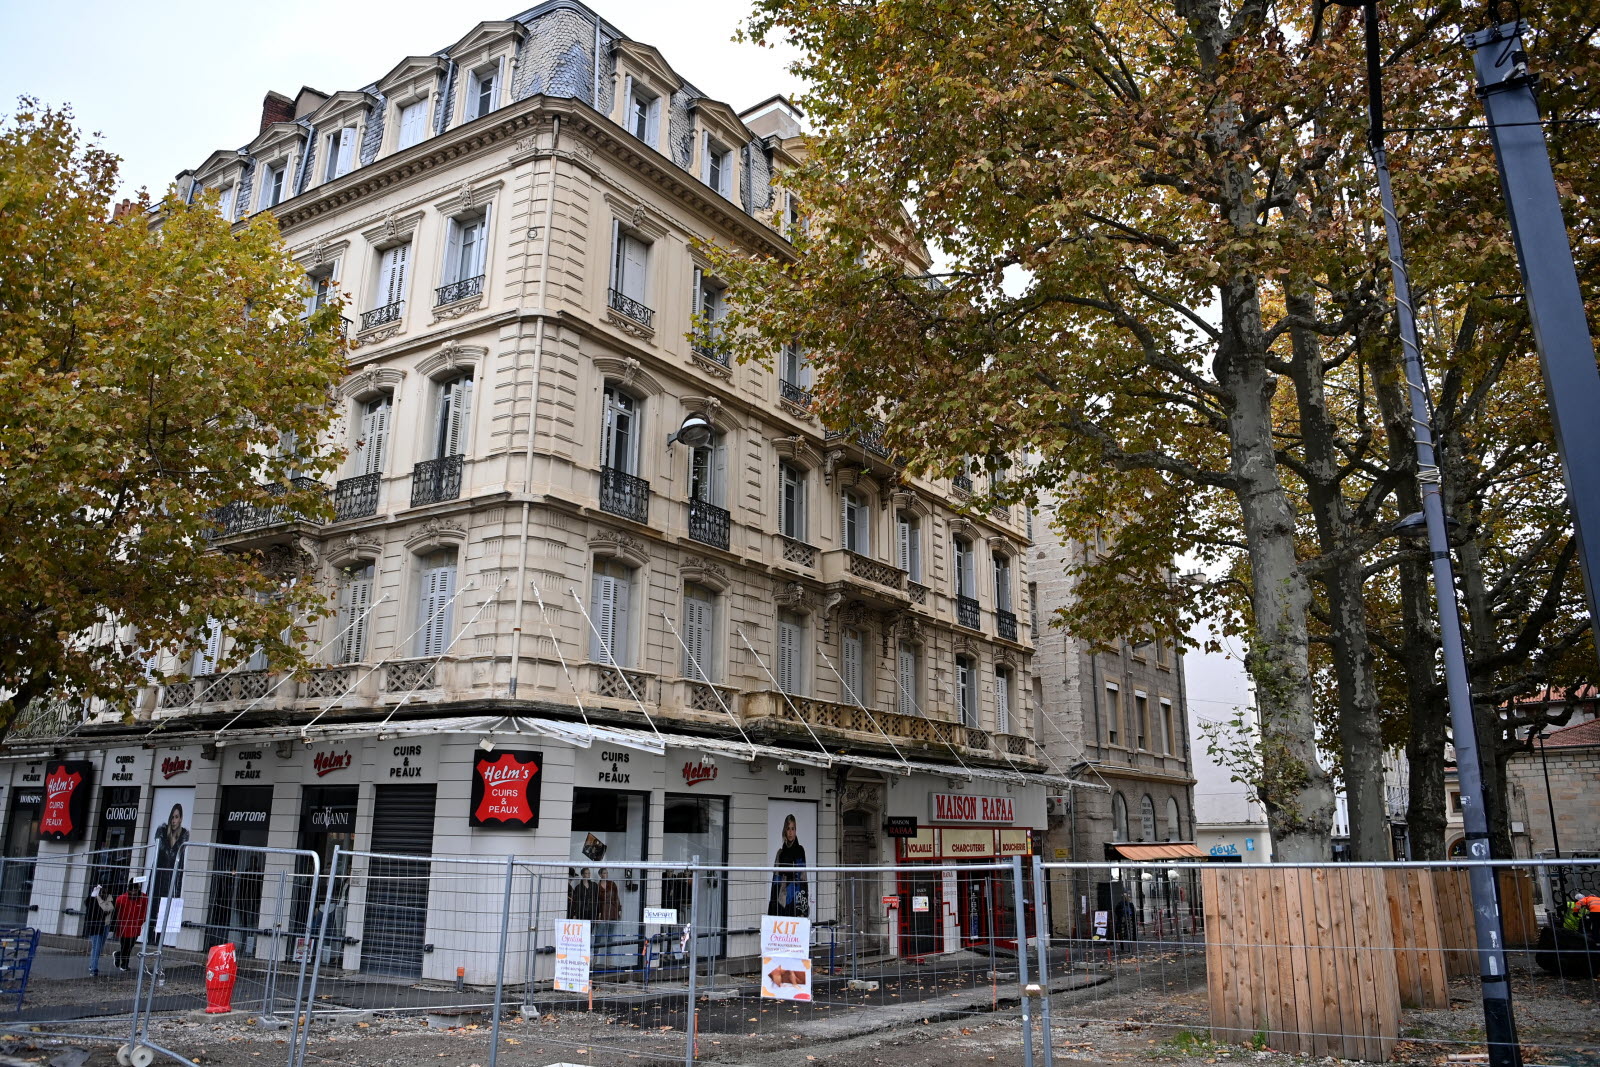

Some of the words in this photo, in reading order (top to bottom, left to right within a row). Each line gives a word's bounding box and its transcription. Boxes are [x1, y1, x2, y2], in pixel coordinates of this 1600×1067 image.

[239, 751, 262, 760] CUIRS
[394, 745, 422, 756] CUIRS
[314, 750, 352, 771] Helm's
[403, 757, 409, 766] &
[602, 751, 629, 763] CUIRS
[162, 756, 192, 774] Helm's
[246, 761, 252, 769] &
[612, 763, 618, 772] &
[235, 770, 261, 779] PEAUX
[390, 767, 421, 777] PEAUX
[484, 765, 529, 781] Helm's
[682, 762, 717, 780] Helm's
[599, 772, 630, 783] PEAUX
[48, 778, 74, 794] Helm's
[784, 785, 806, 793] PEAUX
[936, 794, 976, 820] MAISON
[982, 798, 1014, 821] RAFAA
[106, 807, 137, 820] GIORGIO
[228, 812, 266, 821] DAYTONA
[908, 844, 932, 853] VOLAILLE
[952, 844, 985, 852] CHARCUTERIE
[564, 923, 583, 935] KIT
[773, 921, 799, 934] KIT
